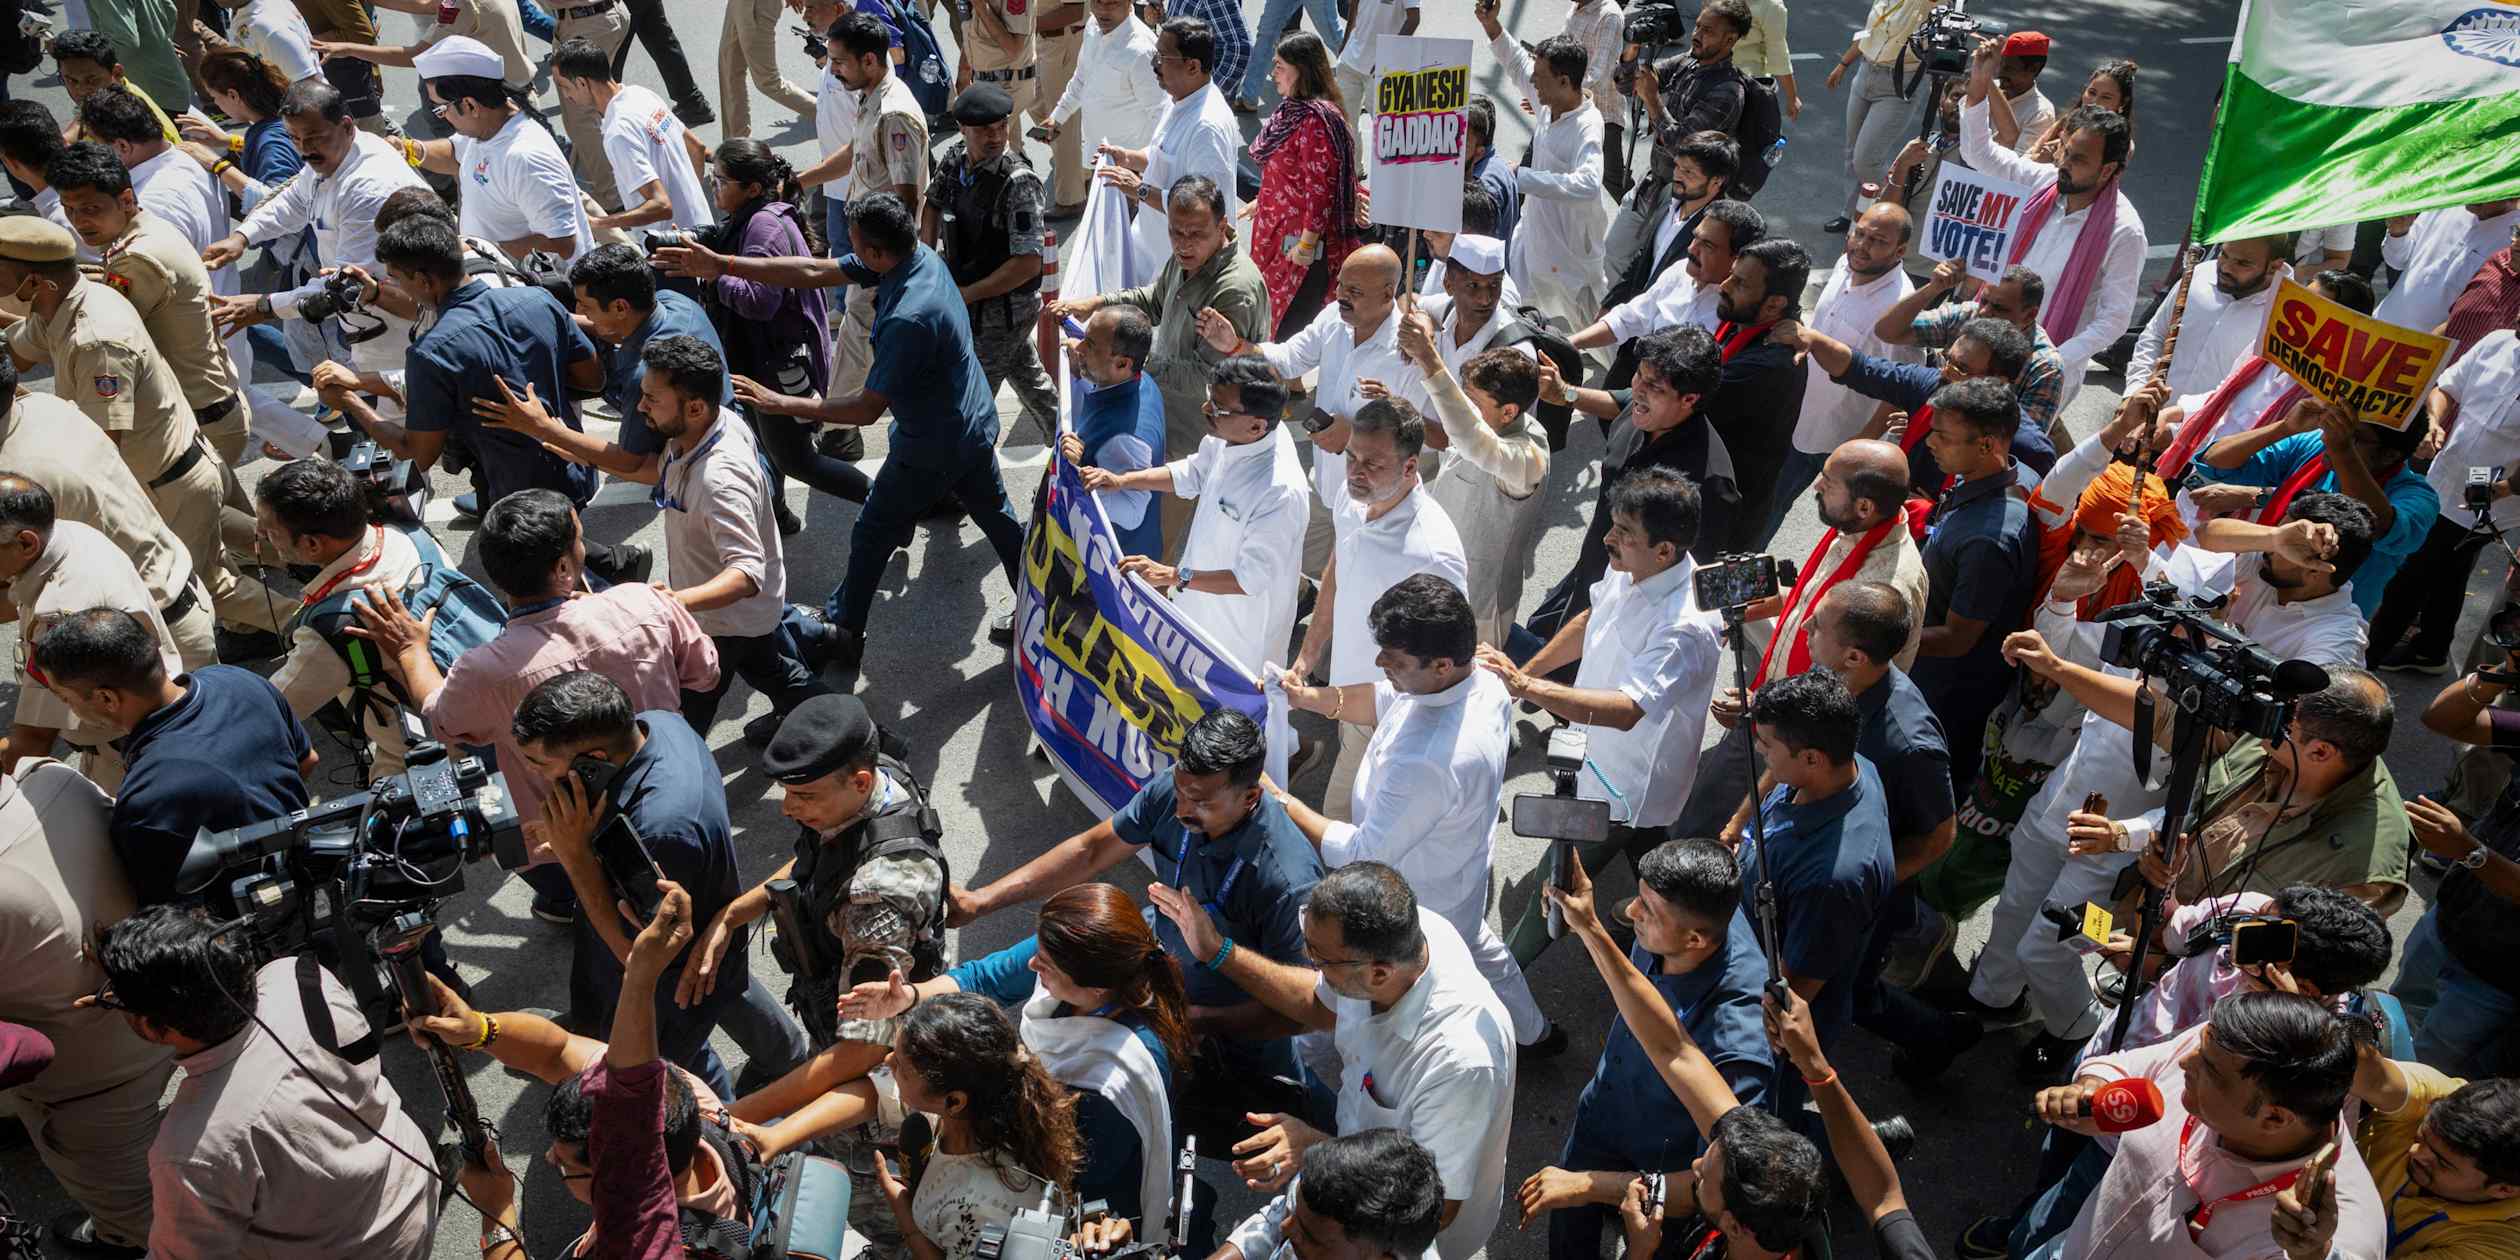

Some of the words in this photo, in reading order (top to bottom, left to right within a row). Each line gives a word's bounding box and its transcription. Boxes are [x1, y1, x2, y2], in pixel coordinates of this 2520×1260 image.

[1379, 69, 1466, 112] GYANESH
[1378, 114, 1459, 158] GADDAR
[1936, 179, 1983, 220] SAVE
[1975, 191, 2020, 229] MY
[1931, 216, 2006, 274] VOTE!
[2275, 299, 2433, 395] SAVE
[2268, 334, 2414, 418] DEMOCRACY!
